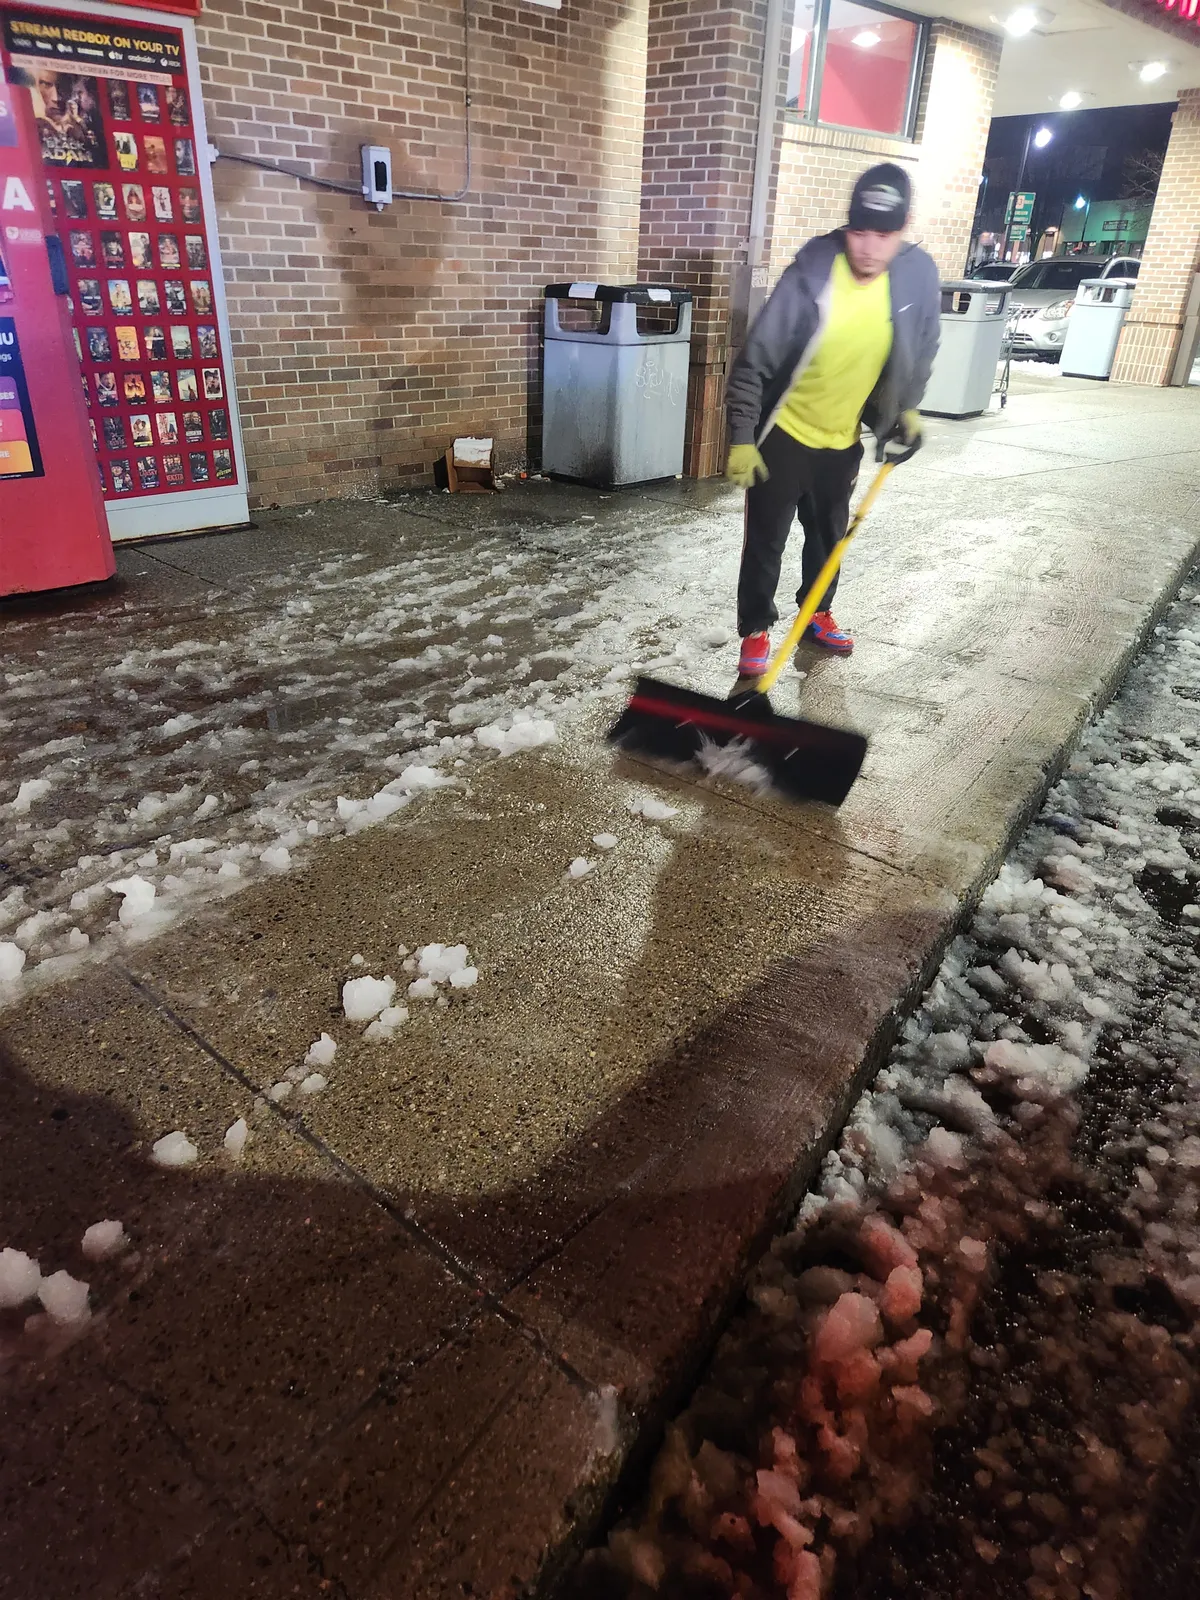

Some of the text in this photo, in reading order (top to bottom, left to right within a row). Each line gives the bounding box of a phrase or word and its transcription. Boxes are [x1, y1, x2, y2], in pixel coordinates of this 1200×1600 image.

[10, 21, 61, 39] STREAM
[63, 28, 111, 46] REDBOX
[113, 37, 131, 48] ON
[133, 39, 163, 54] YOUR
[164, 44, 180, 56] TV
[126, 71, 147, 80] MORE
[42, 149, 93, 163] ADAM
[2, 176, 35, 212] A
